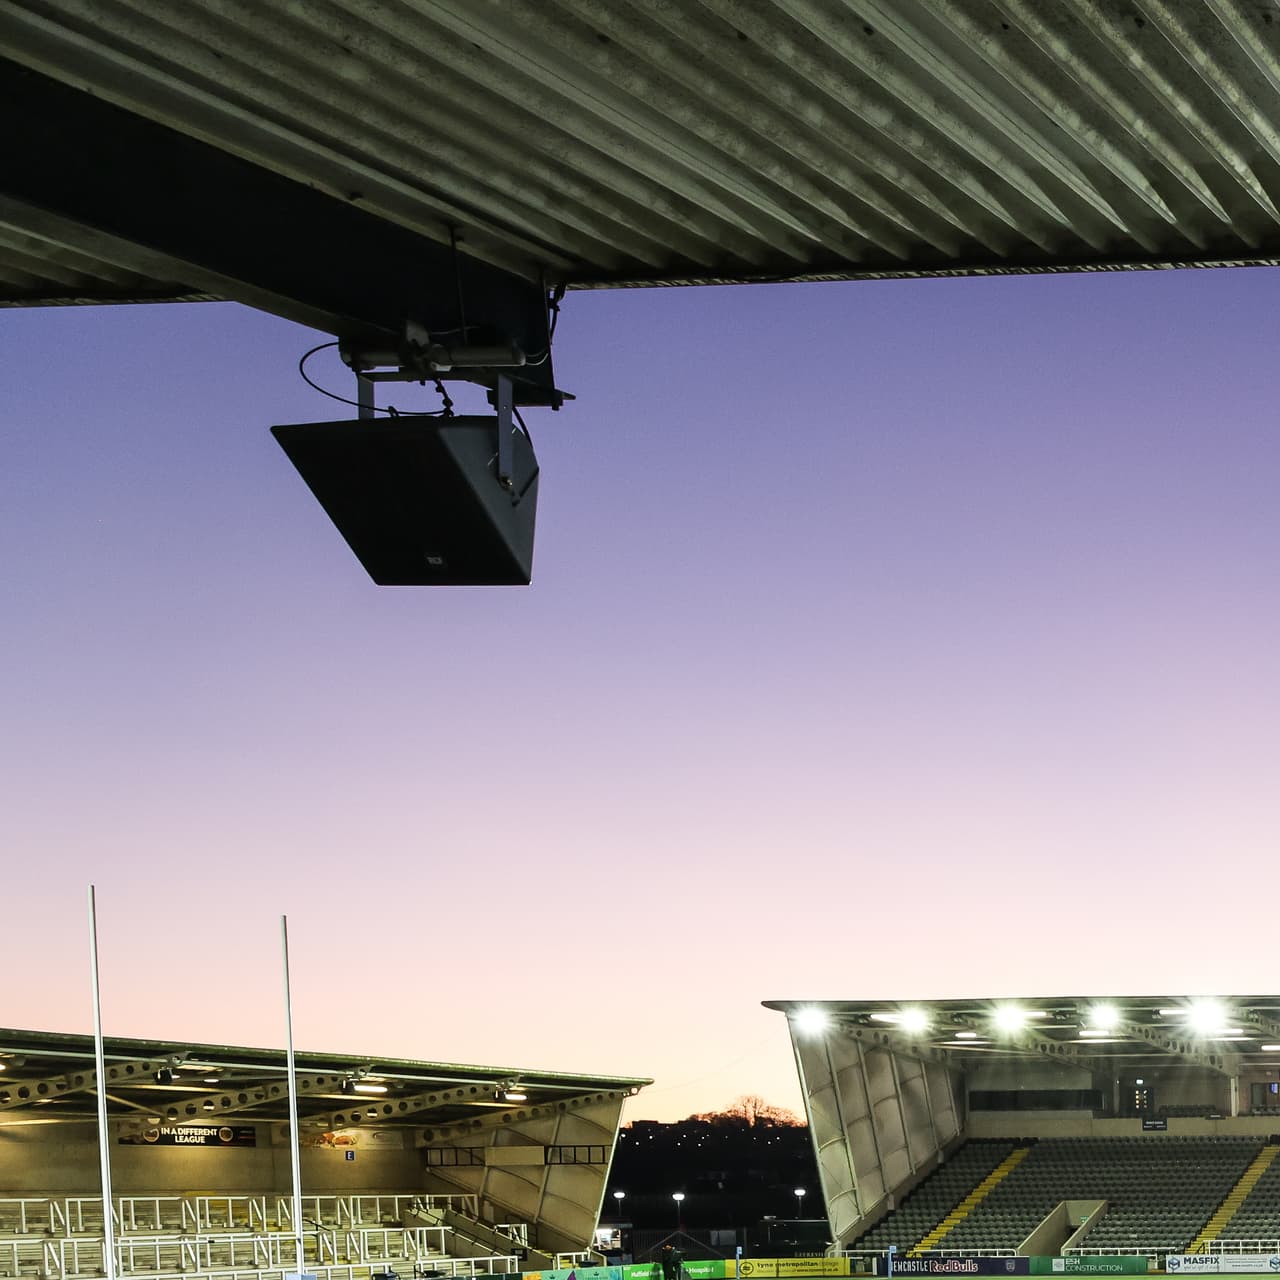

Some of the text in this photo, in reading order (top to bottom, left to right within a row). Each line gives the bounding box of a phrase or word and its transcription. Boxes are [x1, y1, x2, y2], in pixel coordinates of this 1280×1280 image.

[161, 1127, 170, 1135] IN
[178, 1128, 217, 1136] DIFFERENT
[891, 1260, 978, 1272] EWCASTLE Red Bulls
[1065, 1264, 1123, 1272] CONSTRUCTION
